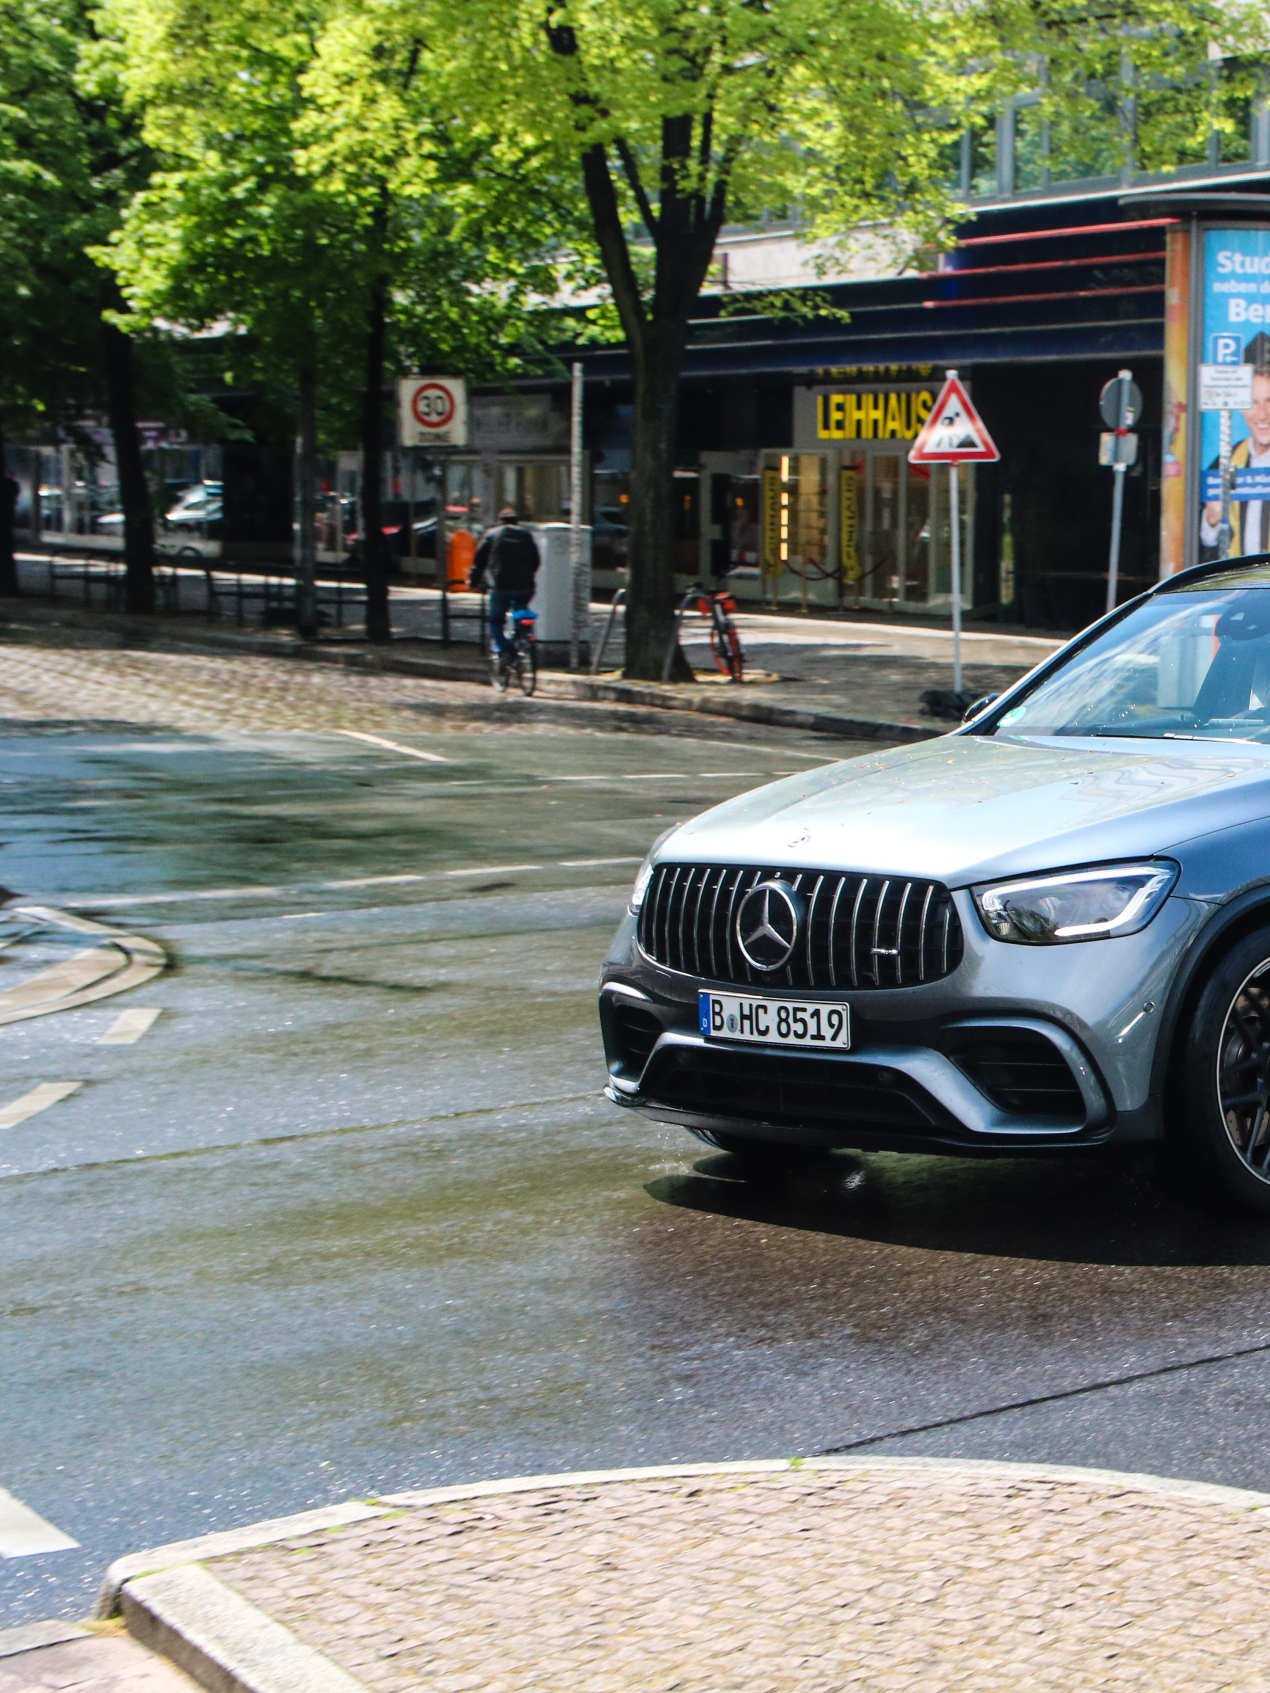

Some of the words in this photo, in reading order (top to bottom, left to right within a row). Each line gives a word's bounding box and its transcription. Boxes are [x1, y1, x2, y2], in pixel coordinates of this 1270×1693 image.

[1216, 337, 1236, 362] P
[420, 394, 446, 416] 30
[817, 390, 934, 440] LEIHHAUS
[711, 998, 725, 1032] B
[739, 1001, 770, 1037] HC
[776, 1005, 844, 1042] 8519
